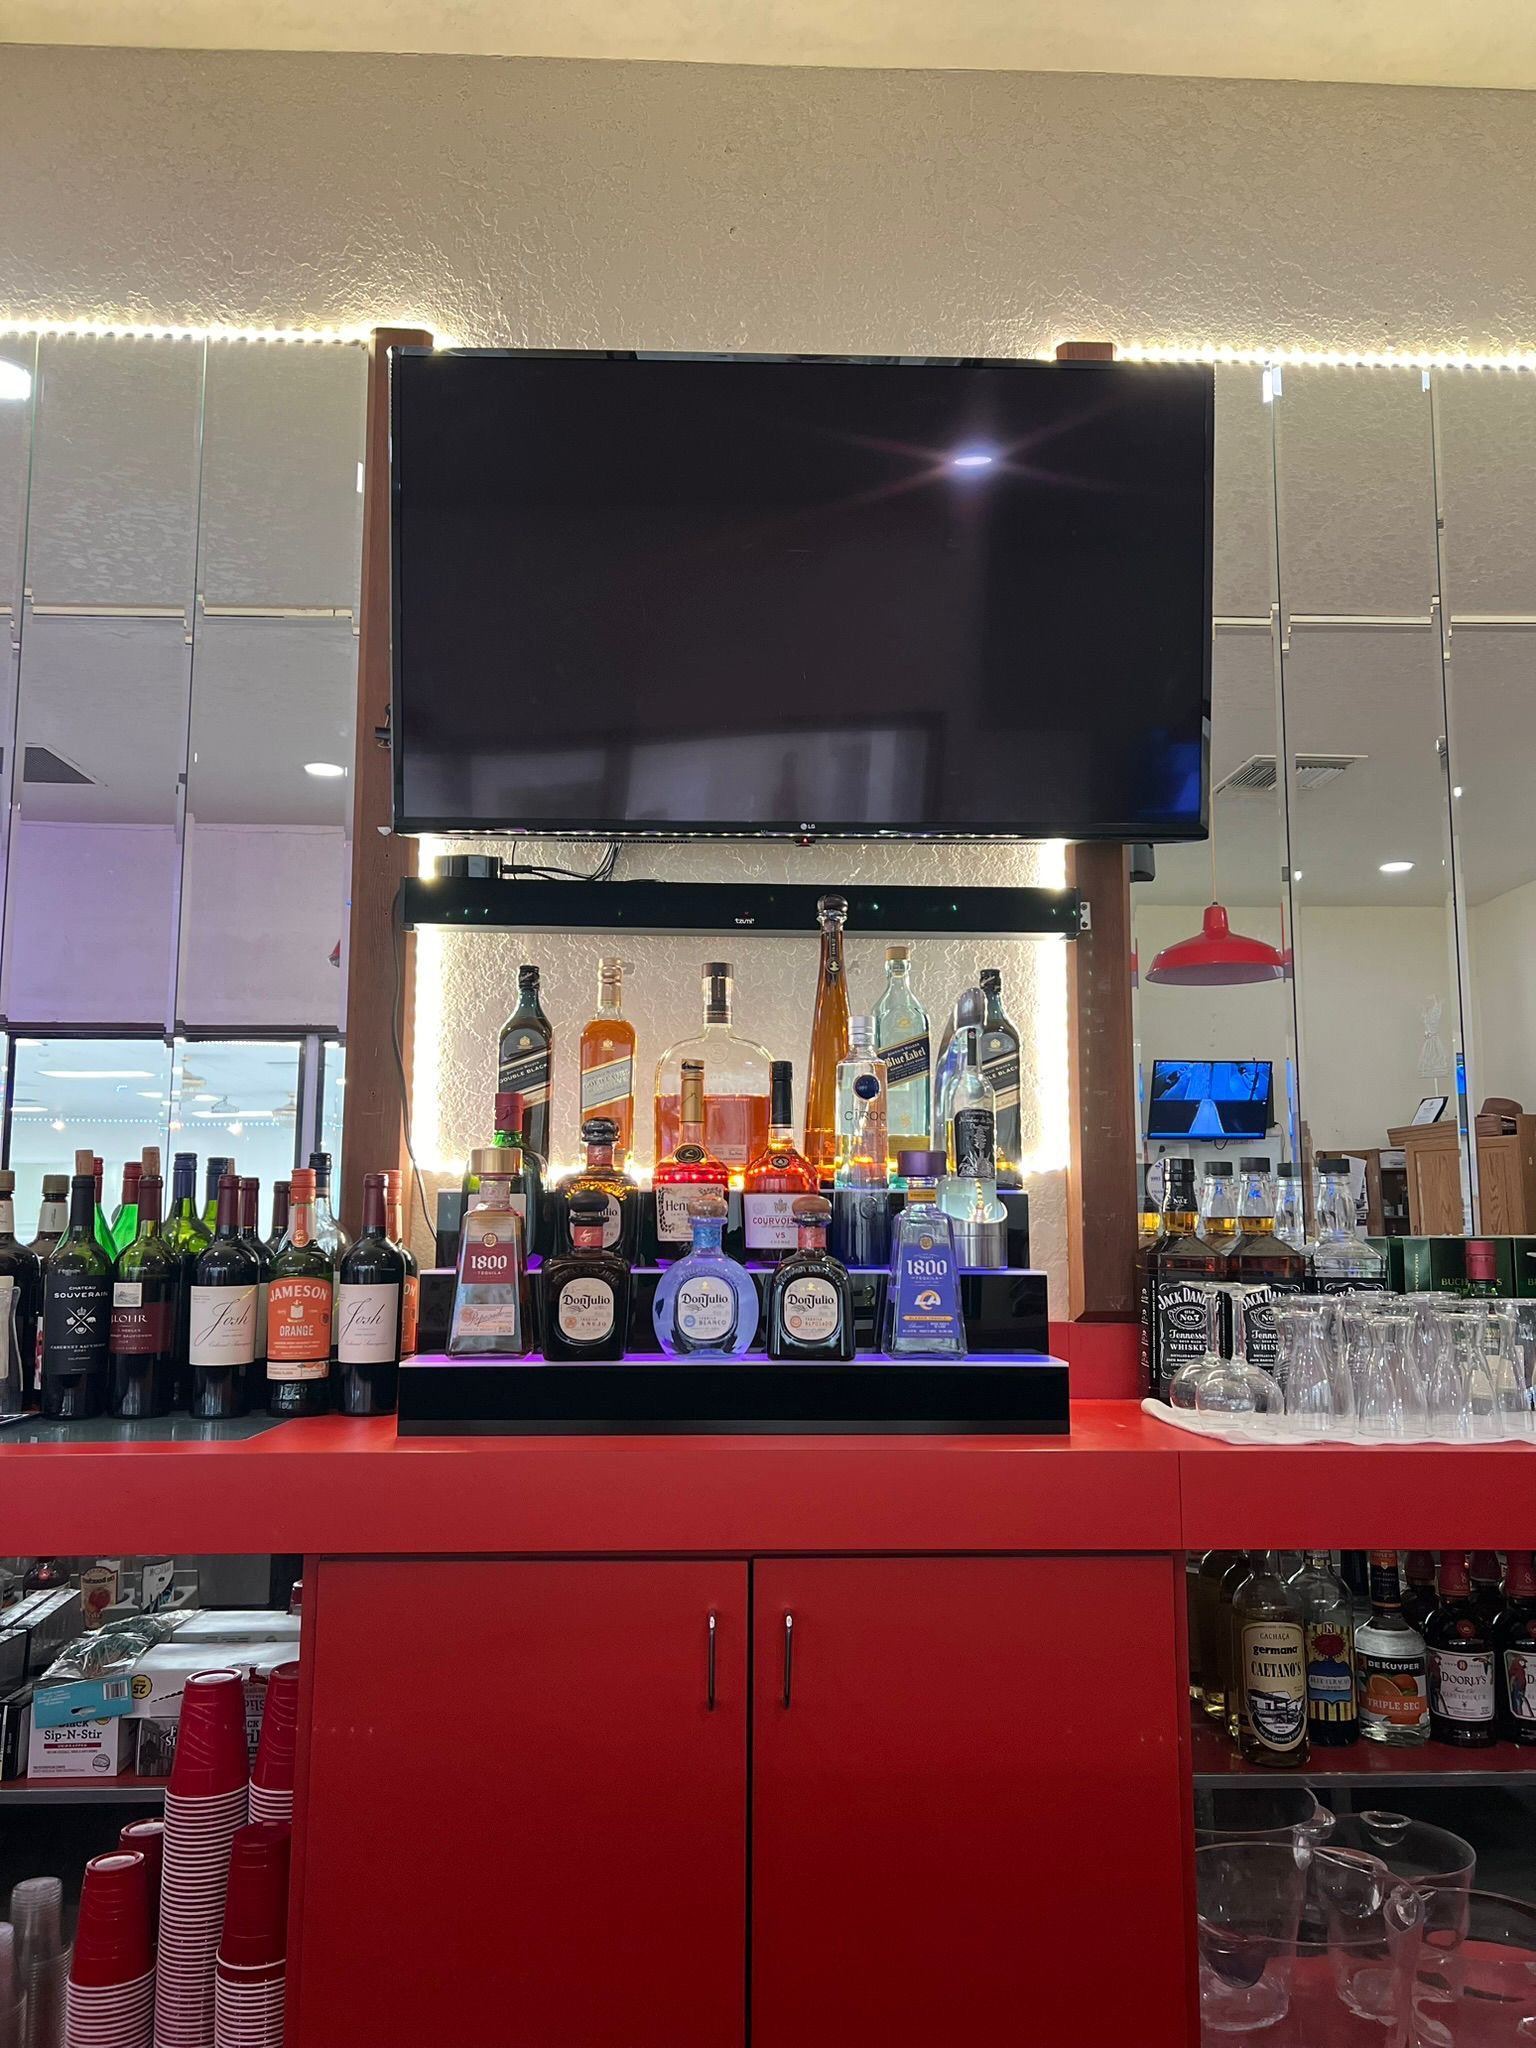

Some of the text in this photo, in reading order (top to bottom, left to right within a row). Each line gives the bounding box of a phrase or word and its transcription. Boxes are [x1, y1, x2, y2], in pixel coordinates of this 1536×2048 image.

[884, 1046, 926, 1068] Blue Label
[526, 1063, 548, 1074] BLACK
[471, 1255, 508, 1270] 1800
[906, 1259, 948, 1276] 1800
[270, 1285, 328, 1302] JAMESON
[1158, 1291, 1182, 1310] JACK
[1242, 1291, 1264, 1311] JACK
[194, 1298, 250, 1347] Josh
[341, 1297, 385, 1341] Josh
[279, 1325, 314, 1337] ORANGE
[1169, 1329, 1208, 1340] Tennesse
[1252, 1329, 1278, 1340] Tenne
[1260, 1632, 1291, 1641] CACHAÇA
[1252, 1645, 1299, 1656] germana
[1251, 1660, 1303, 1678] CAETANO'S
[1368, 1661, 1420, 1670] DE KUYPER
[1442, 1671, 1487, 1686] DOORLY'S
[1368, 1698, 1421, 1711] TRIPLE SEC
[44, 1730, 103, 1743] Sip-N-Stir
